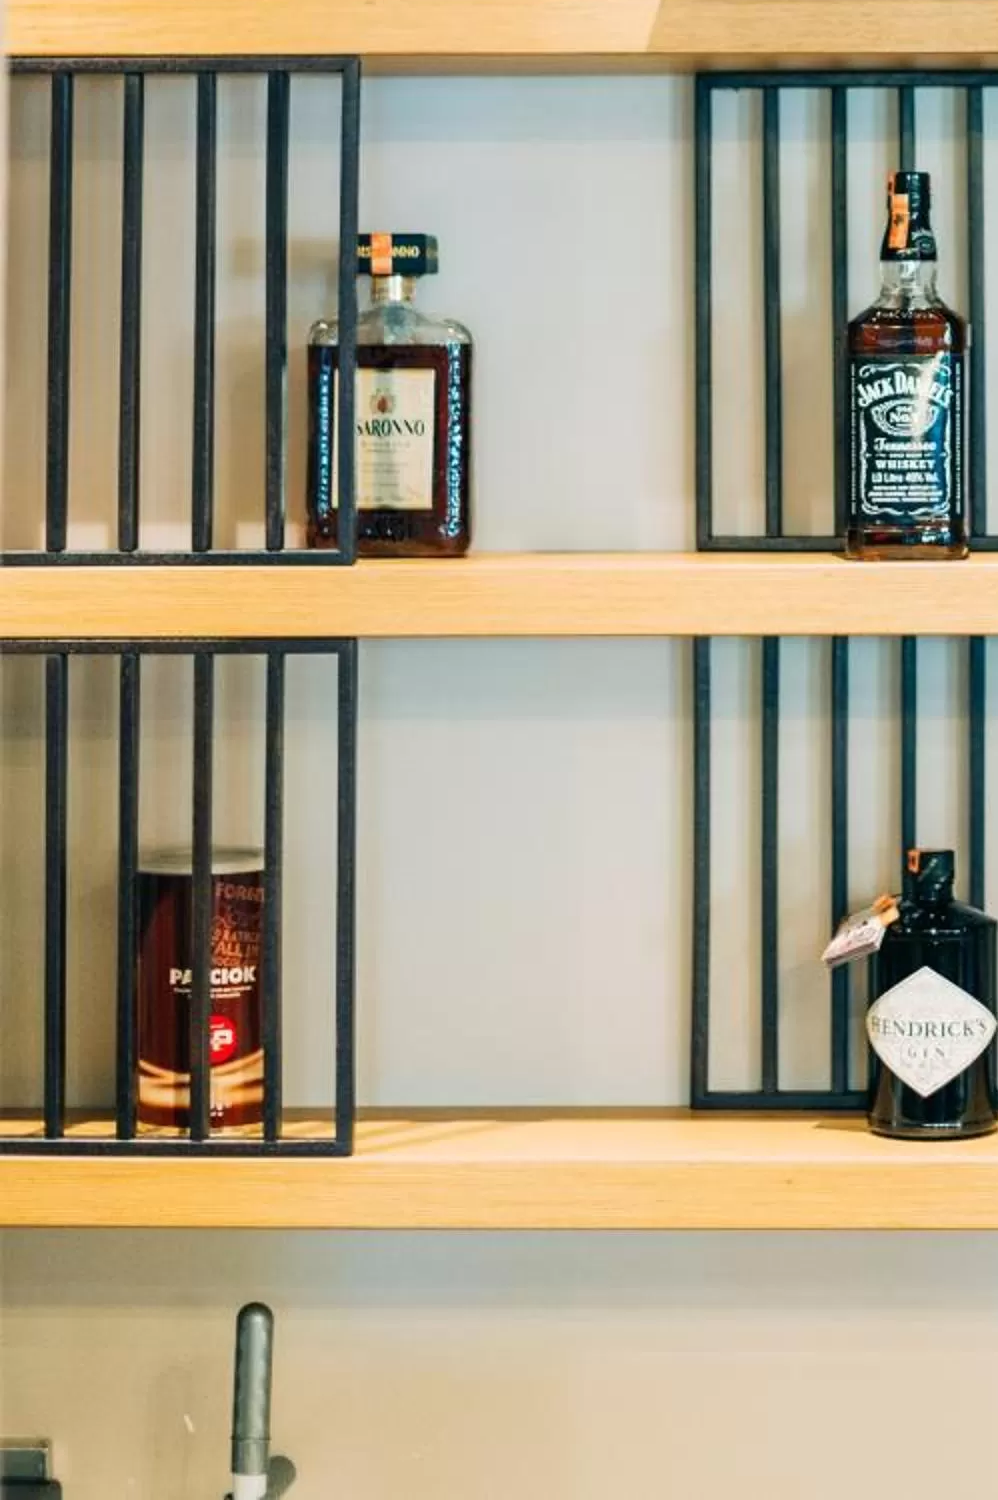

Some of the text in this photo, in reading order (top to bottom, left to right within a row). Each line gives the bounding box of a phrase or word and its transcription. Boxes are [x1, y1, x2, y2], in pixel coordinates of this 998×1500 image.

[857, 377, 894, 407] JACK
[169, 965, 257, 986] PACIOK
[871, 1016, 988, 1038] HENDRICK'S
[907, 1047, 946, 1059] GIN
